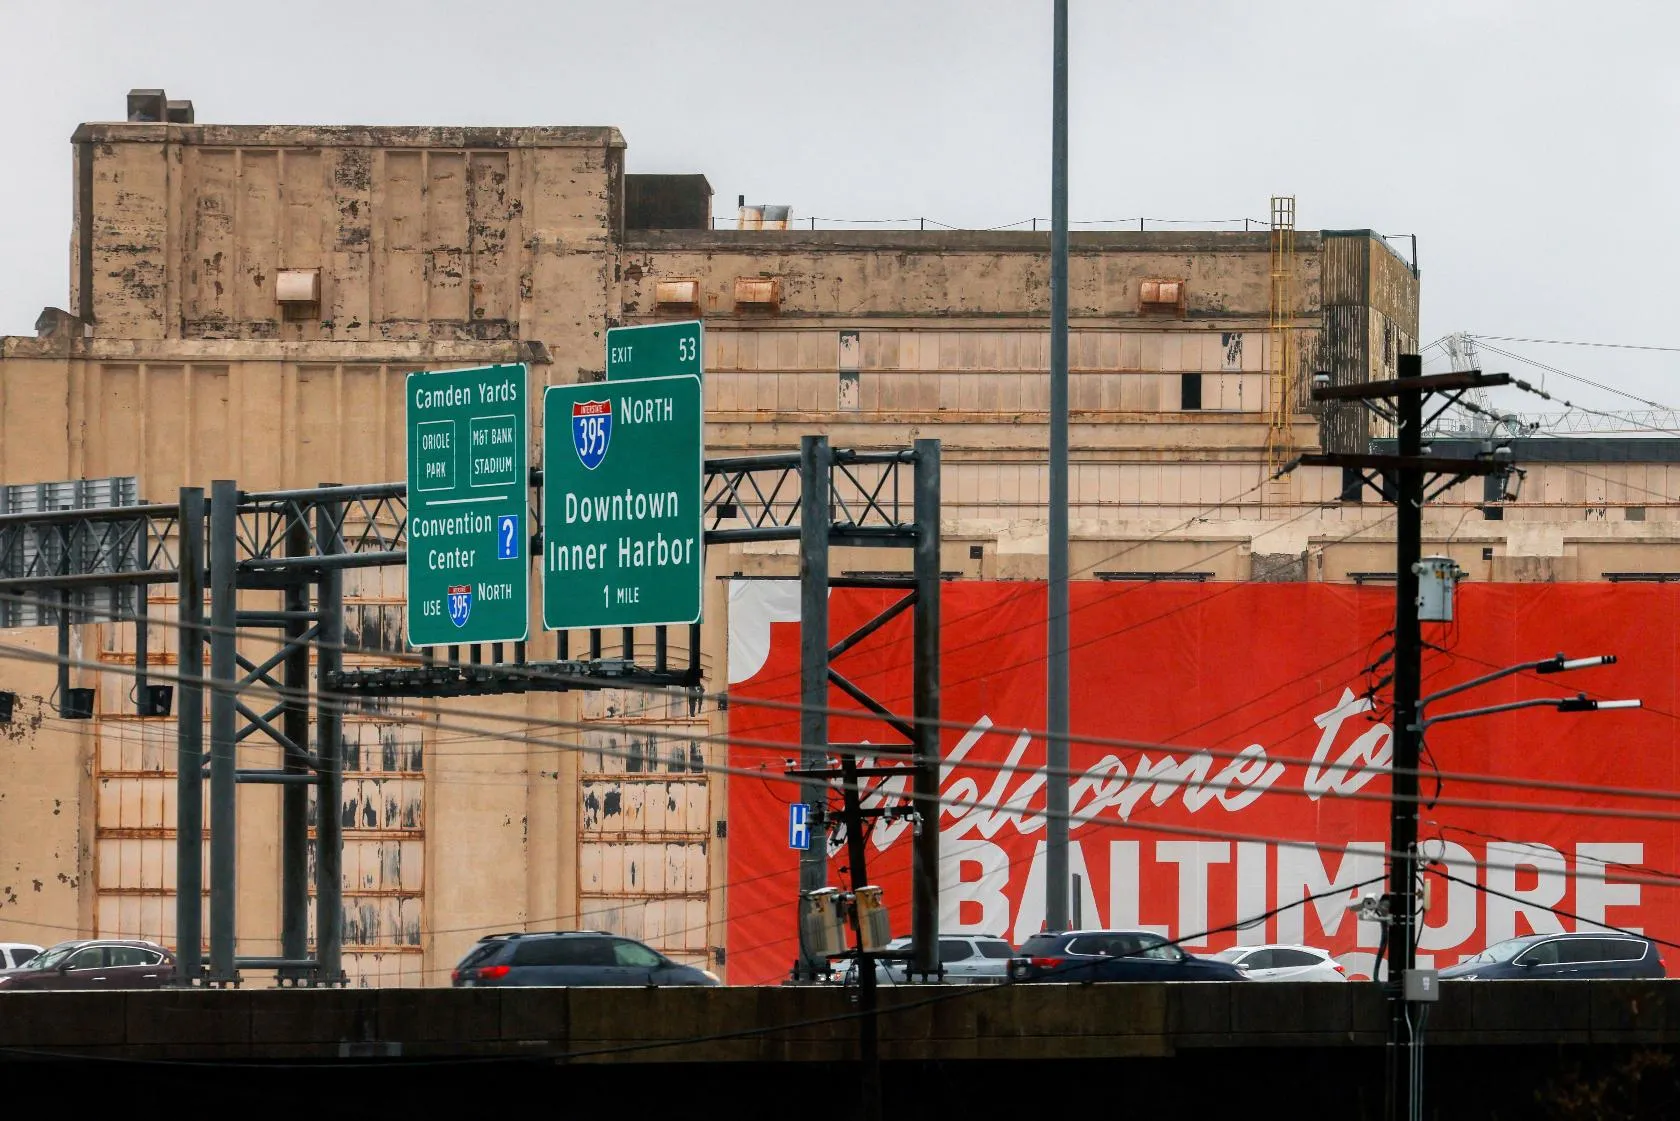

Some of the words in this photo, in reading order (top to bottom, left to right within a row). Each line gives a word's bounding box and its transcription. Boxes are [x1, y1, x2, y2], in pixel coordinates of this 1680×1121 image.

[611, 346, 633, 364] EXIT
[679, 337, 696, 361] 53
[416, 384, 471, 409] Camden
[478, 379, 517, 403] Yards
[422, 432, 450, 451] ORIOLE
[473, 429, 488, 446] M&T
[491, 427, 513, 445] BANK
[579, 417, 605, 457] 395
[426, 461, 446, 479] PARK
[474, 456, 512, 475] STADIUM
[565, 488, 679, 524] Downtown
[412, 511, 492, 538] Convention
[428, 547, 476, 570] Center
[550, 541, 607, 572] Inner
[618, 532, 694, 568] Harbor
[423, 600, 441, 616] USE
[452, 595, 468, 619] 395
[603, 584, 609, 609] 1
[617, 586, 640, 604] MILE
[938, 840, 1645, 947] BALTIMORE
